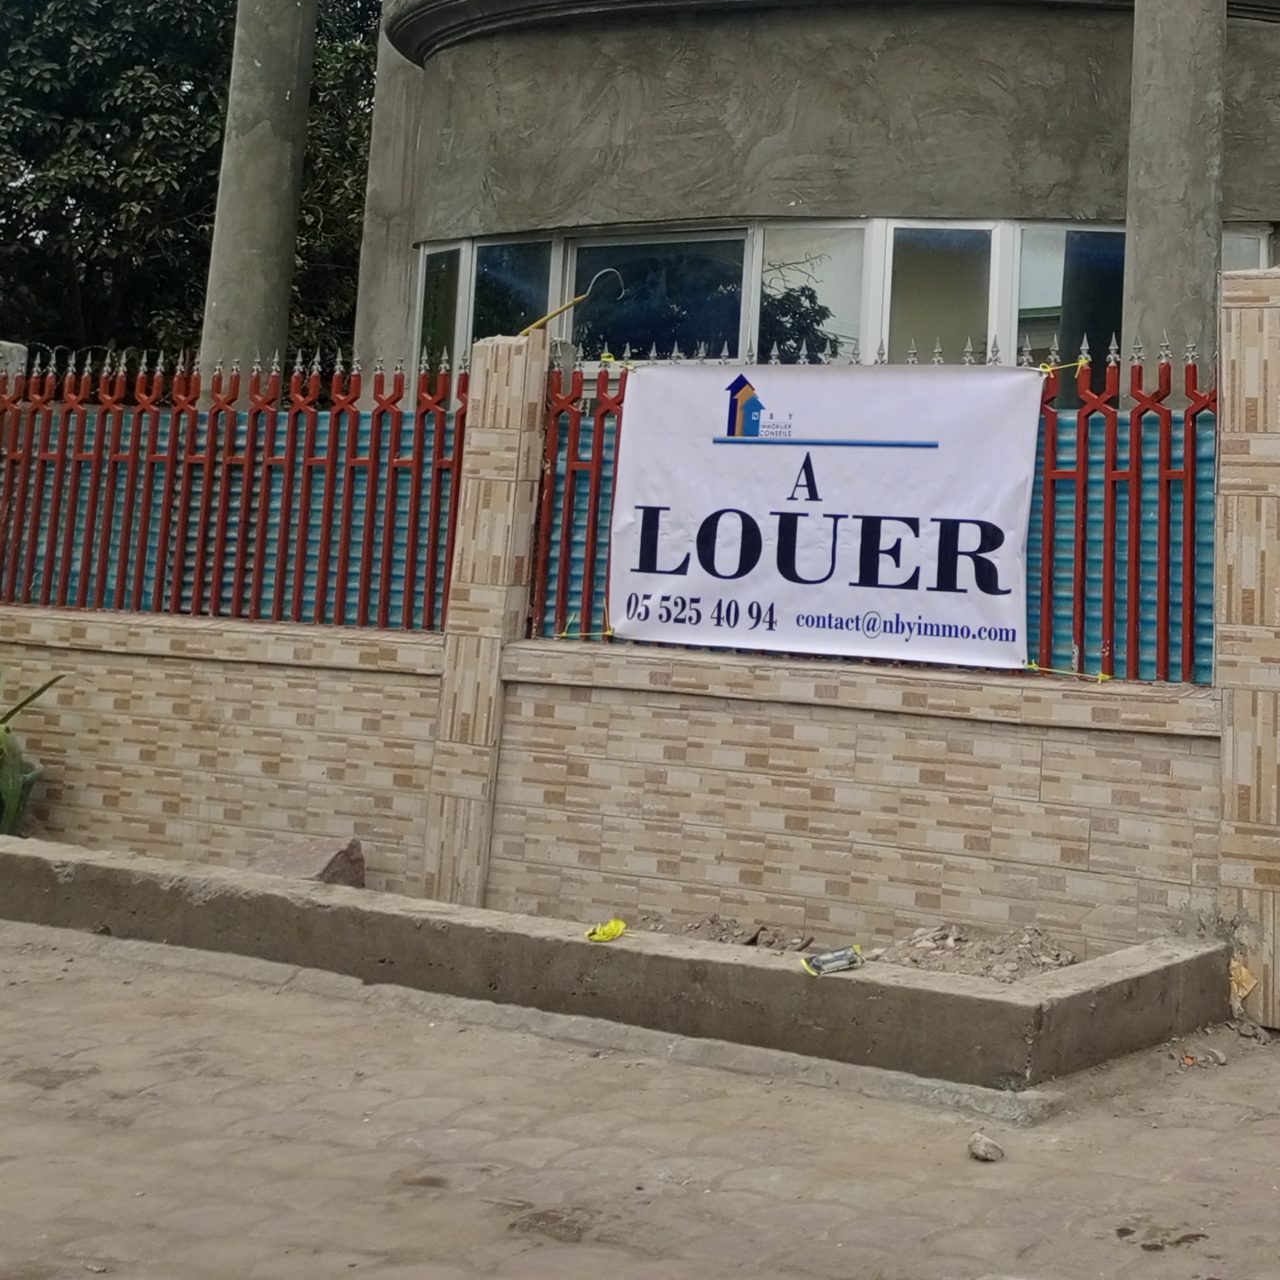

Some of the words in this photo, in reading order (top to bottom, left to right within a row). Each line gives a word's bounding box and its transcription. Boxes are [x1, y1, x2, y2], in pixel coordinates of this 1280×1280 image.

[759, 429, 792, 438] CONSEILS
[786, 451, 823, 502] A
[629, 505, 1012, 596] LOUER
[626, 592, 652, 622] 05
[658, 595, 702, 626] 525
[710, 598, 740, 629] 40
[747, 600, 778, 631] 94
[795, 610, 1017, 643] contact@nbyimmo.com
